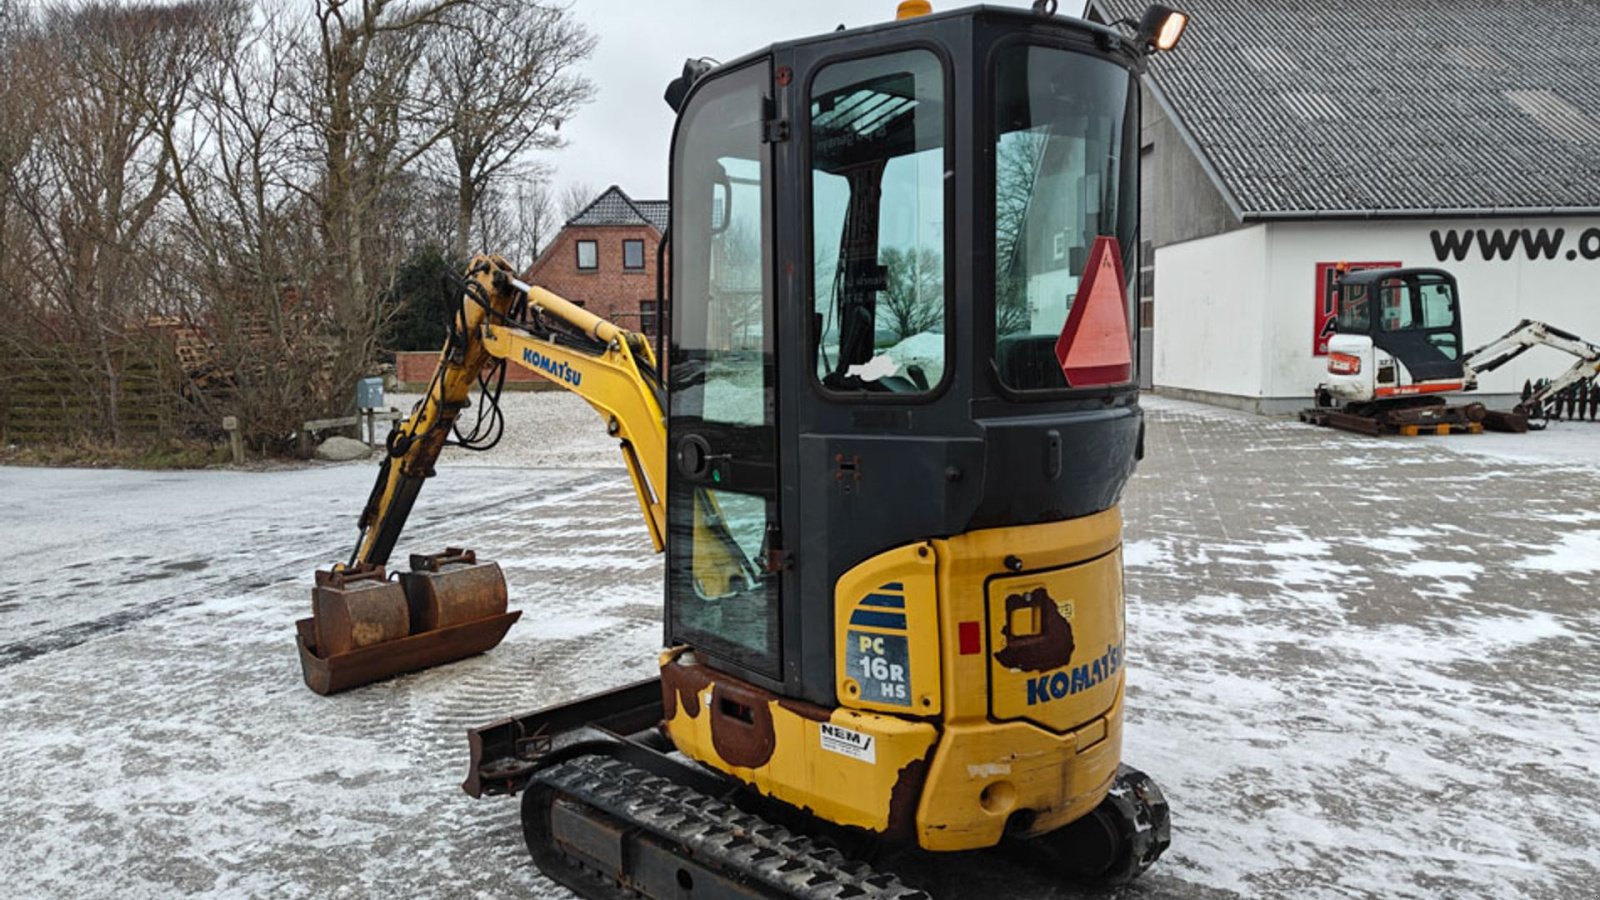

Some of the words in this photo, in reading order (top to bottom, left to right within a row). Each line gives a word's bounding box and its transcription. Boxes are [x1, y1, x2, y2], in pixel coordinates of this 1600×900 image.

[523, 347, 582, 386] KOMATSU
[859, 635, 885, 655] PC
[859, 655, 905, 682] 16R
[881, 682, 906, 699] HS
